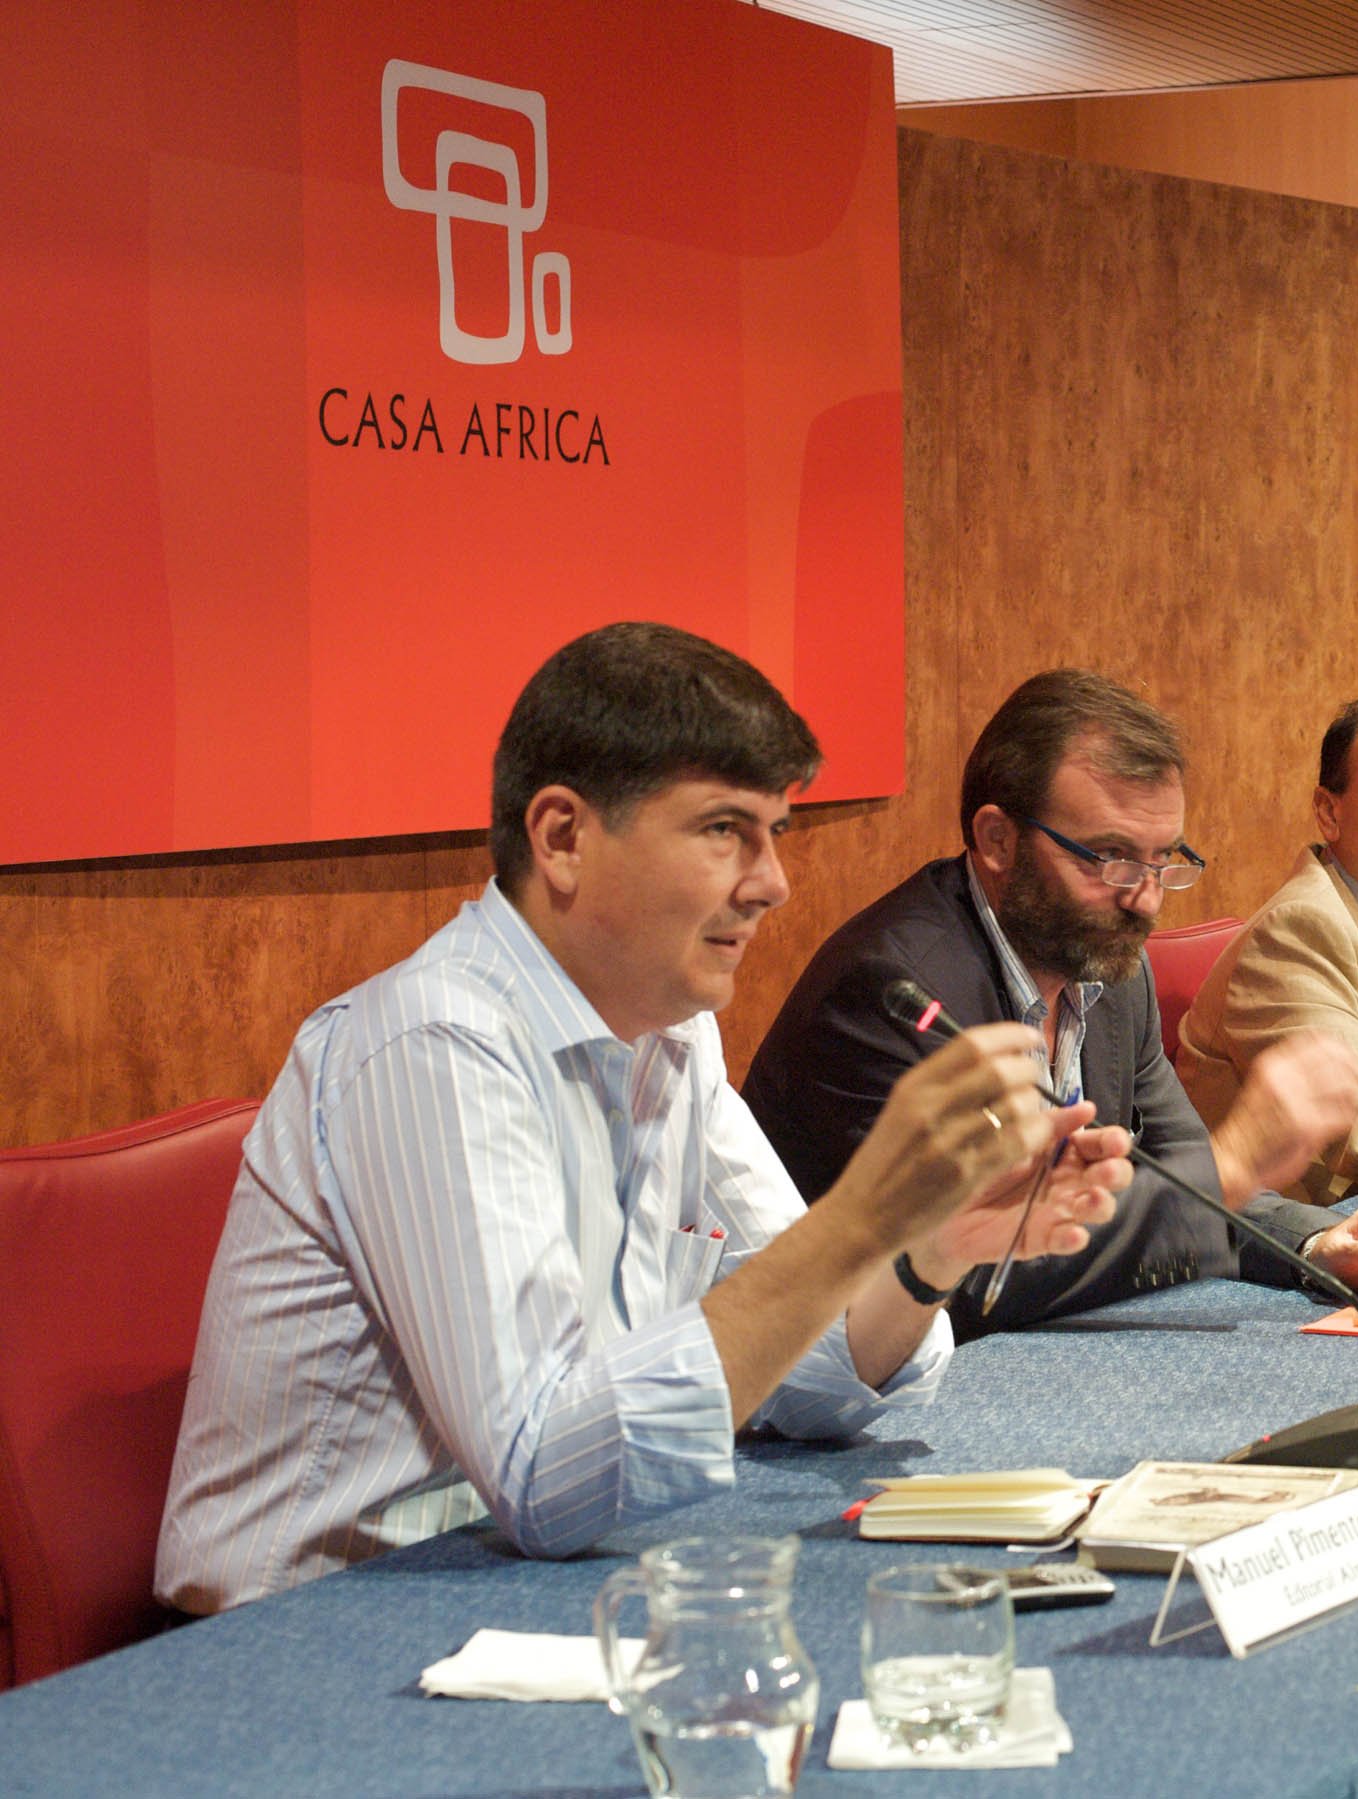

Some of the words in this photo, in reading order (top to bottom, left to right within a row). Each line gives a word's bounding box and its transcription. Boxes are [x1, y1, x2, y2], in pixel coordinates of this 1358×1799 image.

[318, 387, 444, 454] CASA
[460, 401, 611, 466] AFRICA
[1205, 1538, 1289, 1595] Manuel
